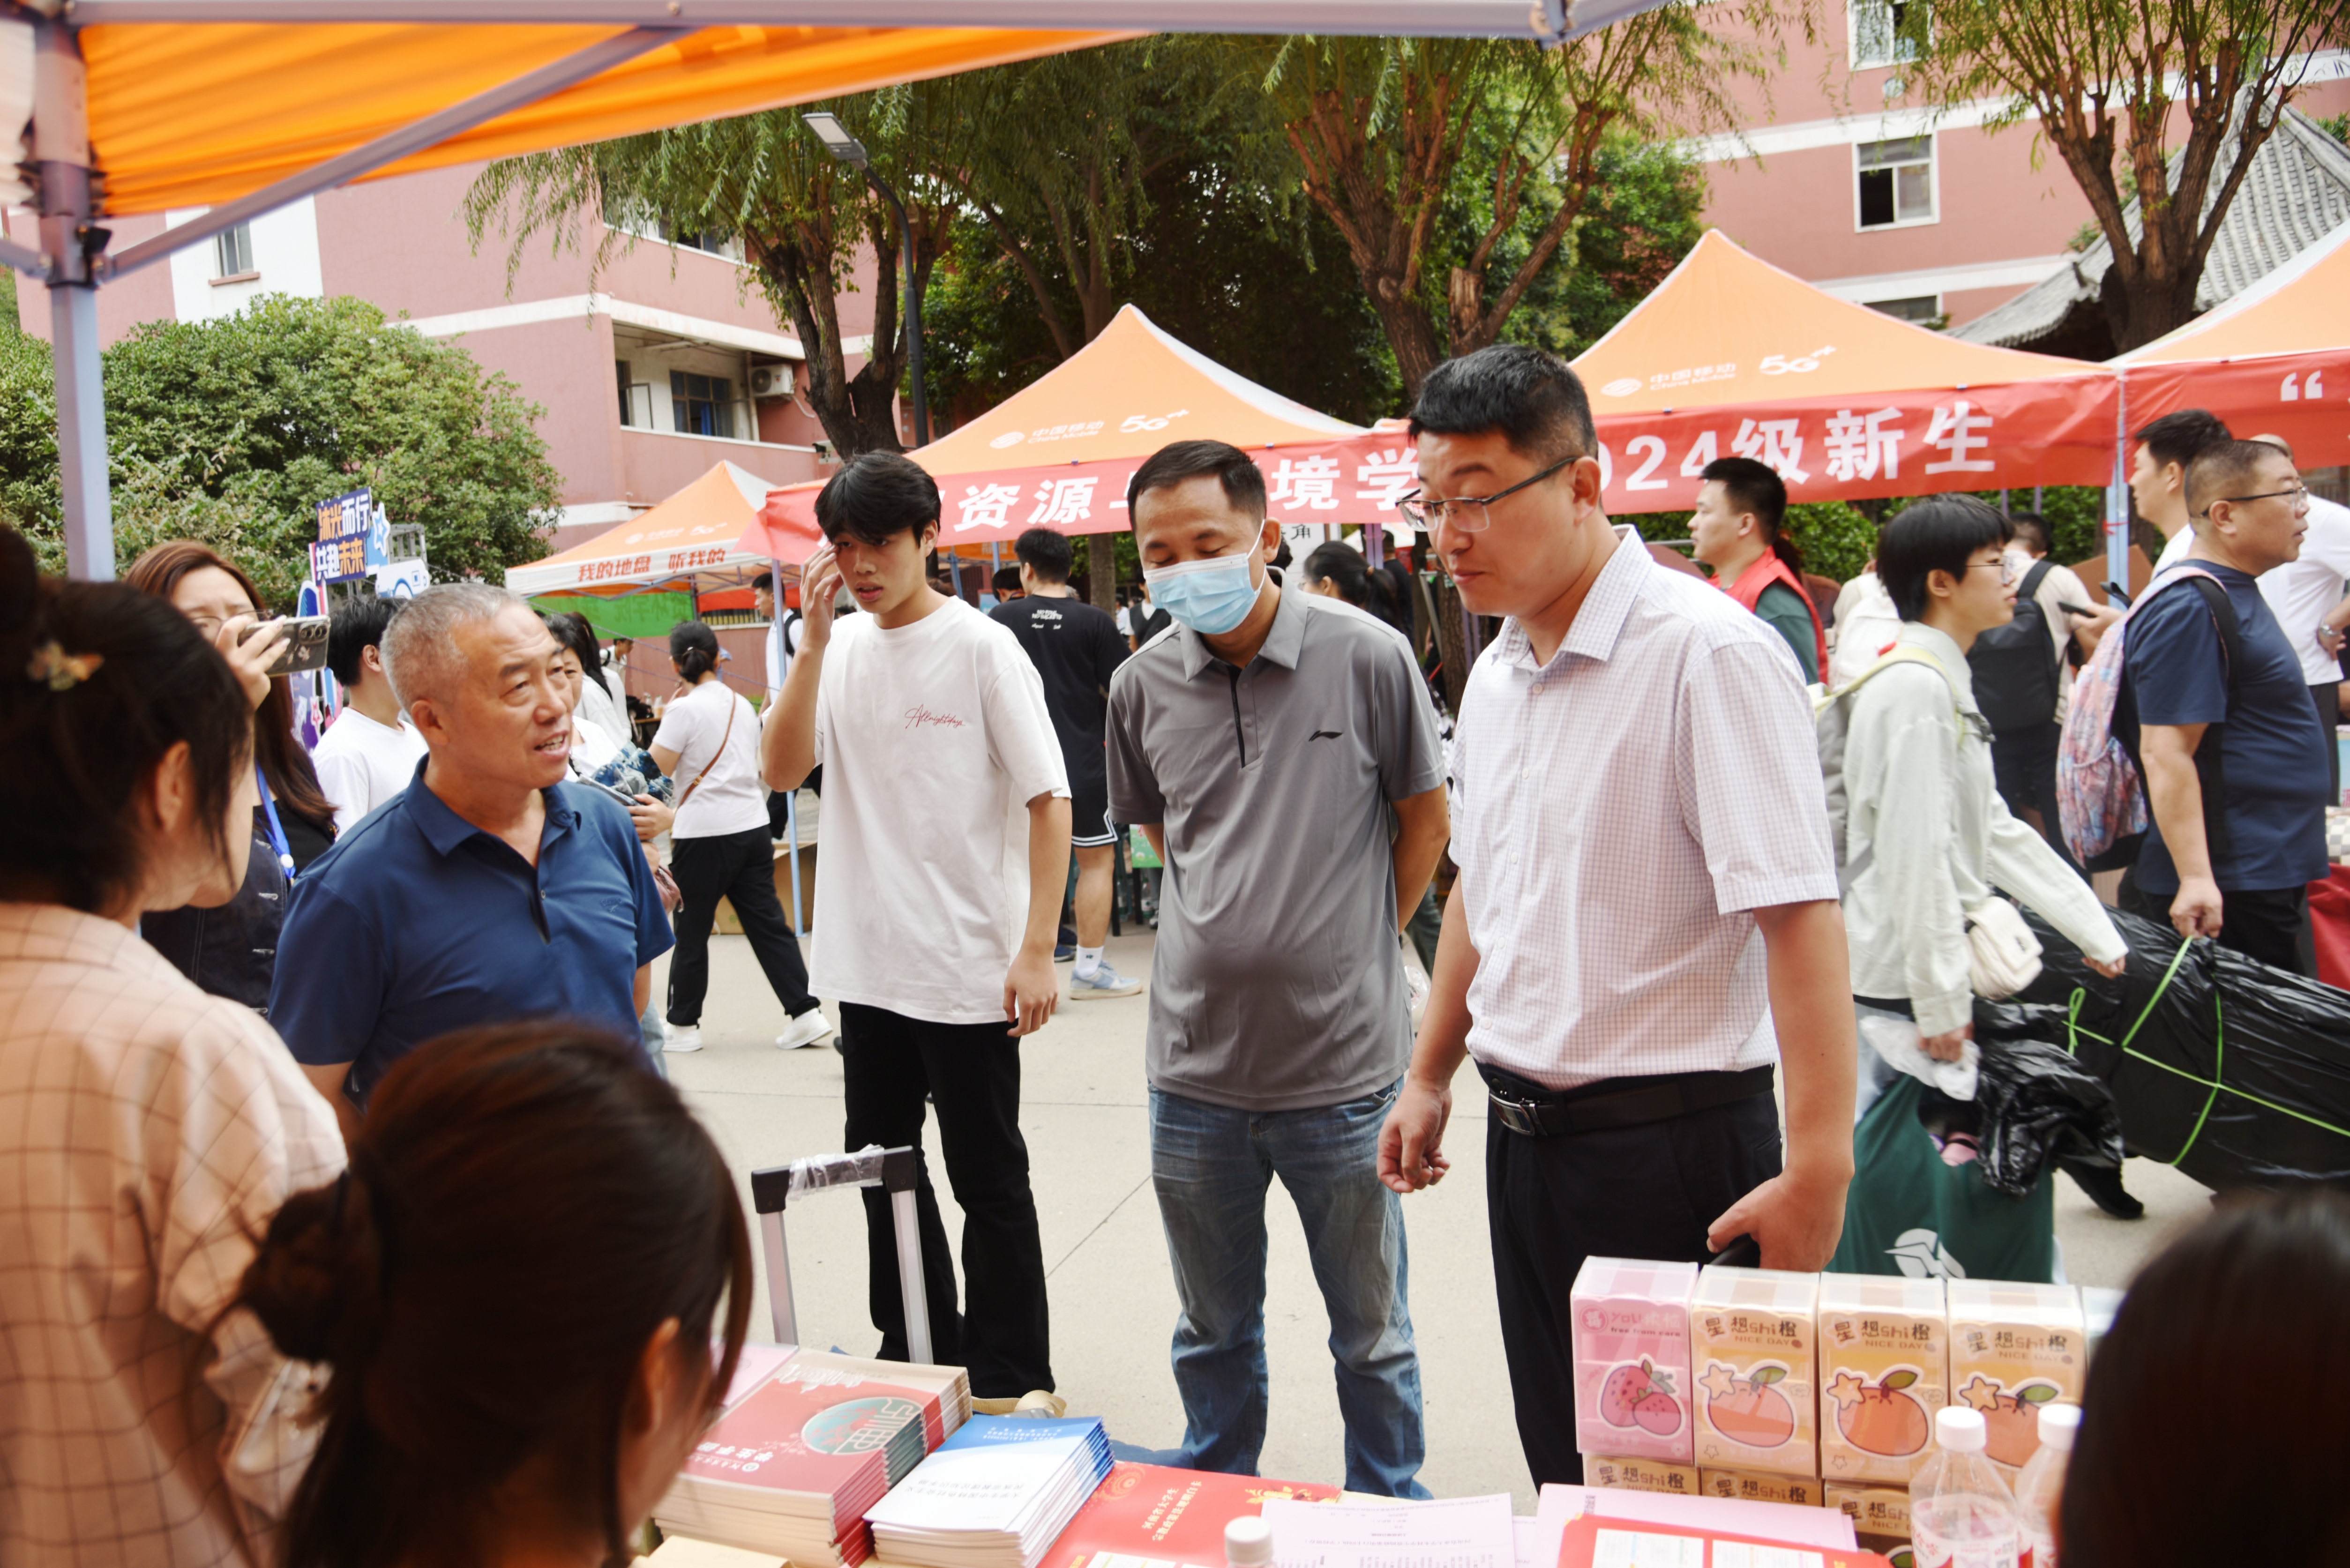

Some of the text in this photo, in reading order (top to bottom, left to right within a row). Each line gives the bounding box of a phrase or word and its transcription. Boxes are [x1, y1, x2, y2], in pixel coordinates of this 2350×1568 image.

[1650, 363, 1736, 384] 中国移动
[1033, 420, 1105, 437] 中国移动
[315, 537, 365, 581] 共赴未来
[578, 548, 726, 582] 我的地盘 听我的
[1735, 1335, 1762, 1344] NICE
[1865, 1340, 1895, 1348] NICE
[1998, 1351, 2028, 1359] NICE
[697, 1441, 773, 1462] 学生手册
[1142, 1488, 1179, 1531] 河南省大学生
[1872, 1521, 1901, 1530] NICE
